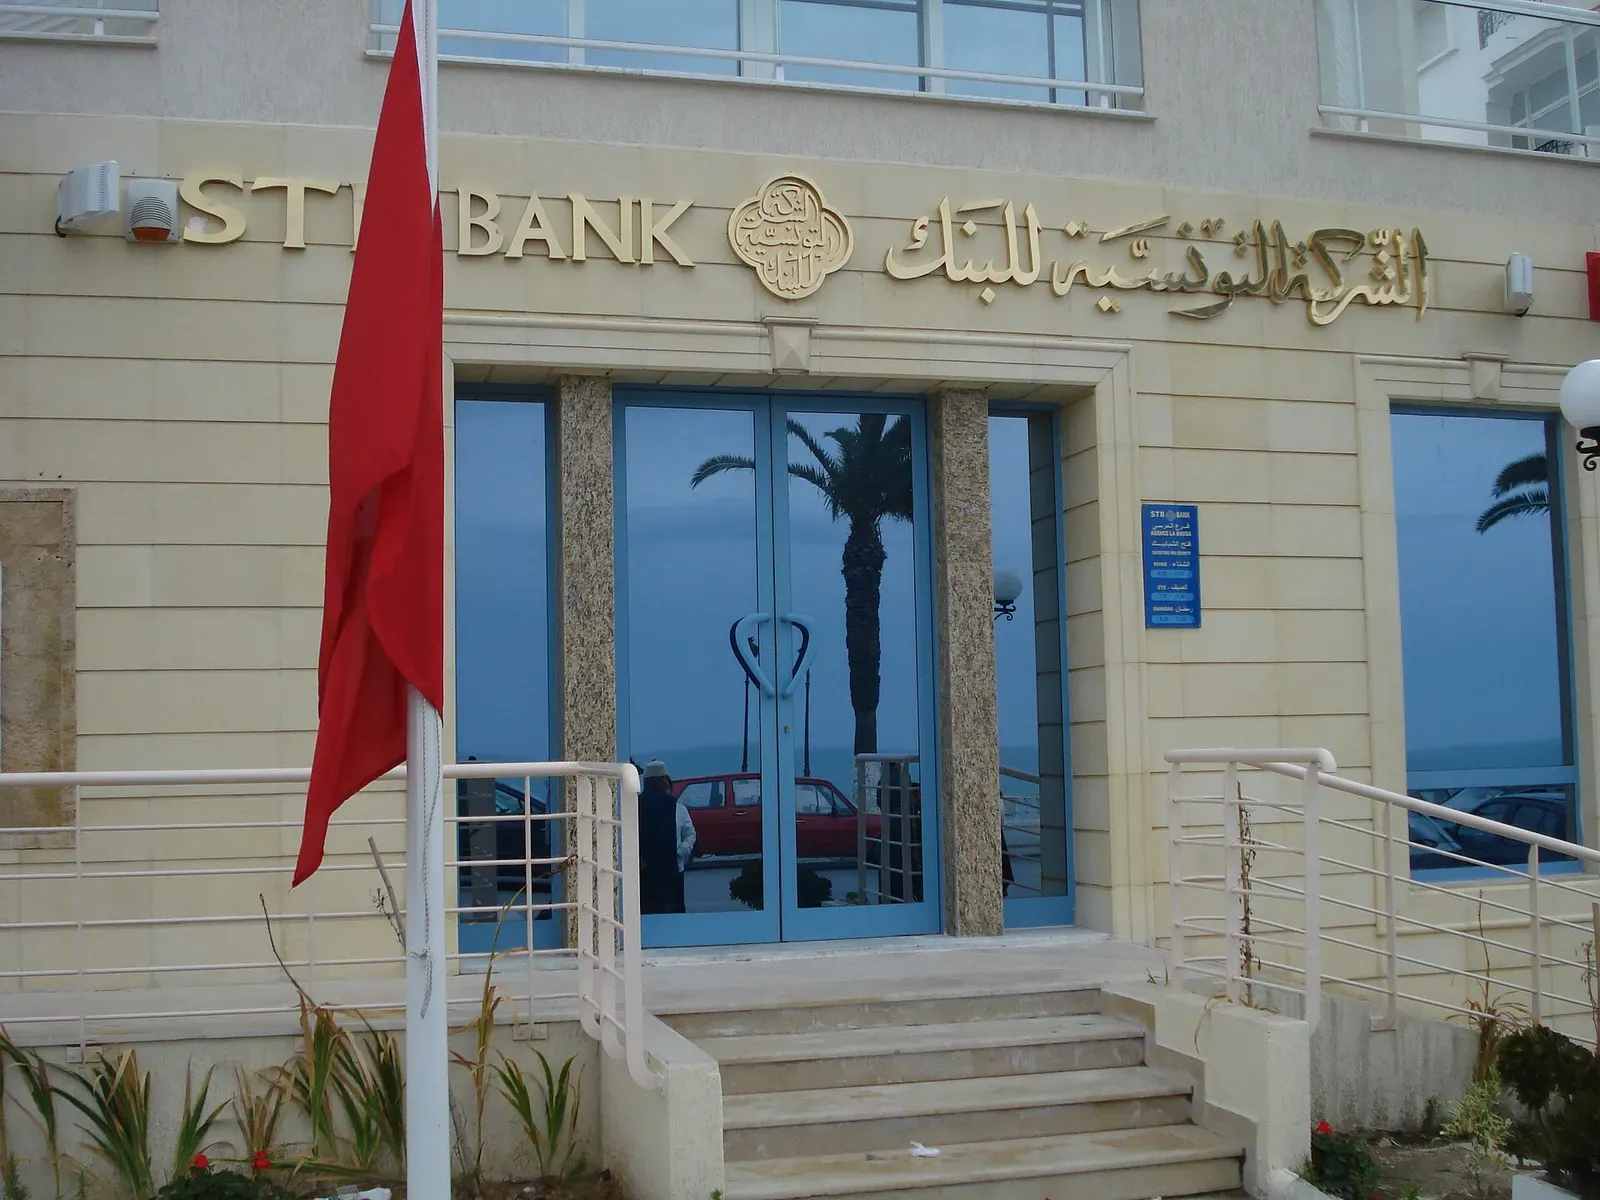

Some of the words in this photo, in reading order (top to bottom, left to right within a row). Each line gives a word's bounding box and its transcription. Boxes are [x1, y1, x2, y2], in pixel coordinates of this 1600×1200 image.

[179, 177, 367, 253] ST
[457, 186, 696, 268] BANK
[1150, 510, 1165, 518] STB
[1176, 511, 1191, 519] BANK
